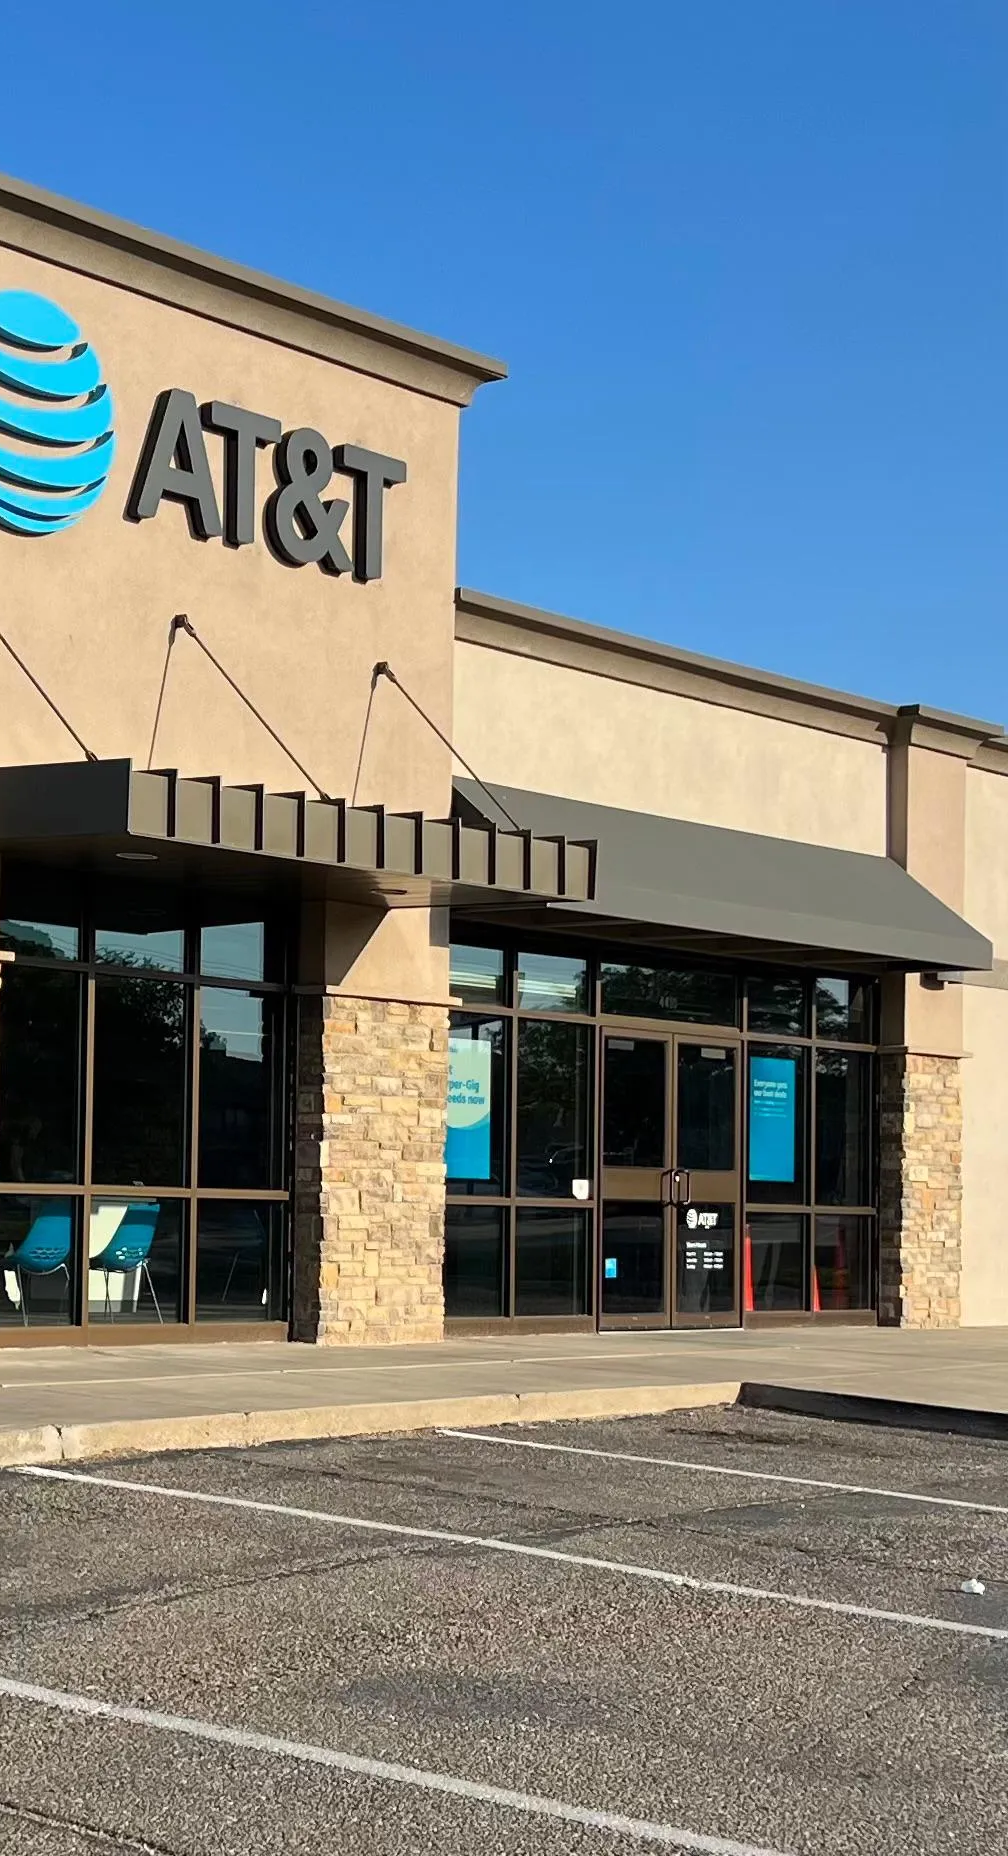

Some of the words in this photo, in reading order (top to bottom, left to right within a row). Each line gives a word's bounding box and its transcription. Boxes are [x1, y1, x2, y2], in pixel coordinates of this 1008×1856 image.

[123, 388, 407, 583] AT&T
[448, 1080, 480, 1093] per-Gig
[447, 1094, 466, 1104] eeds
[468, 1096, 485, 1105] now
